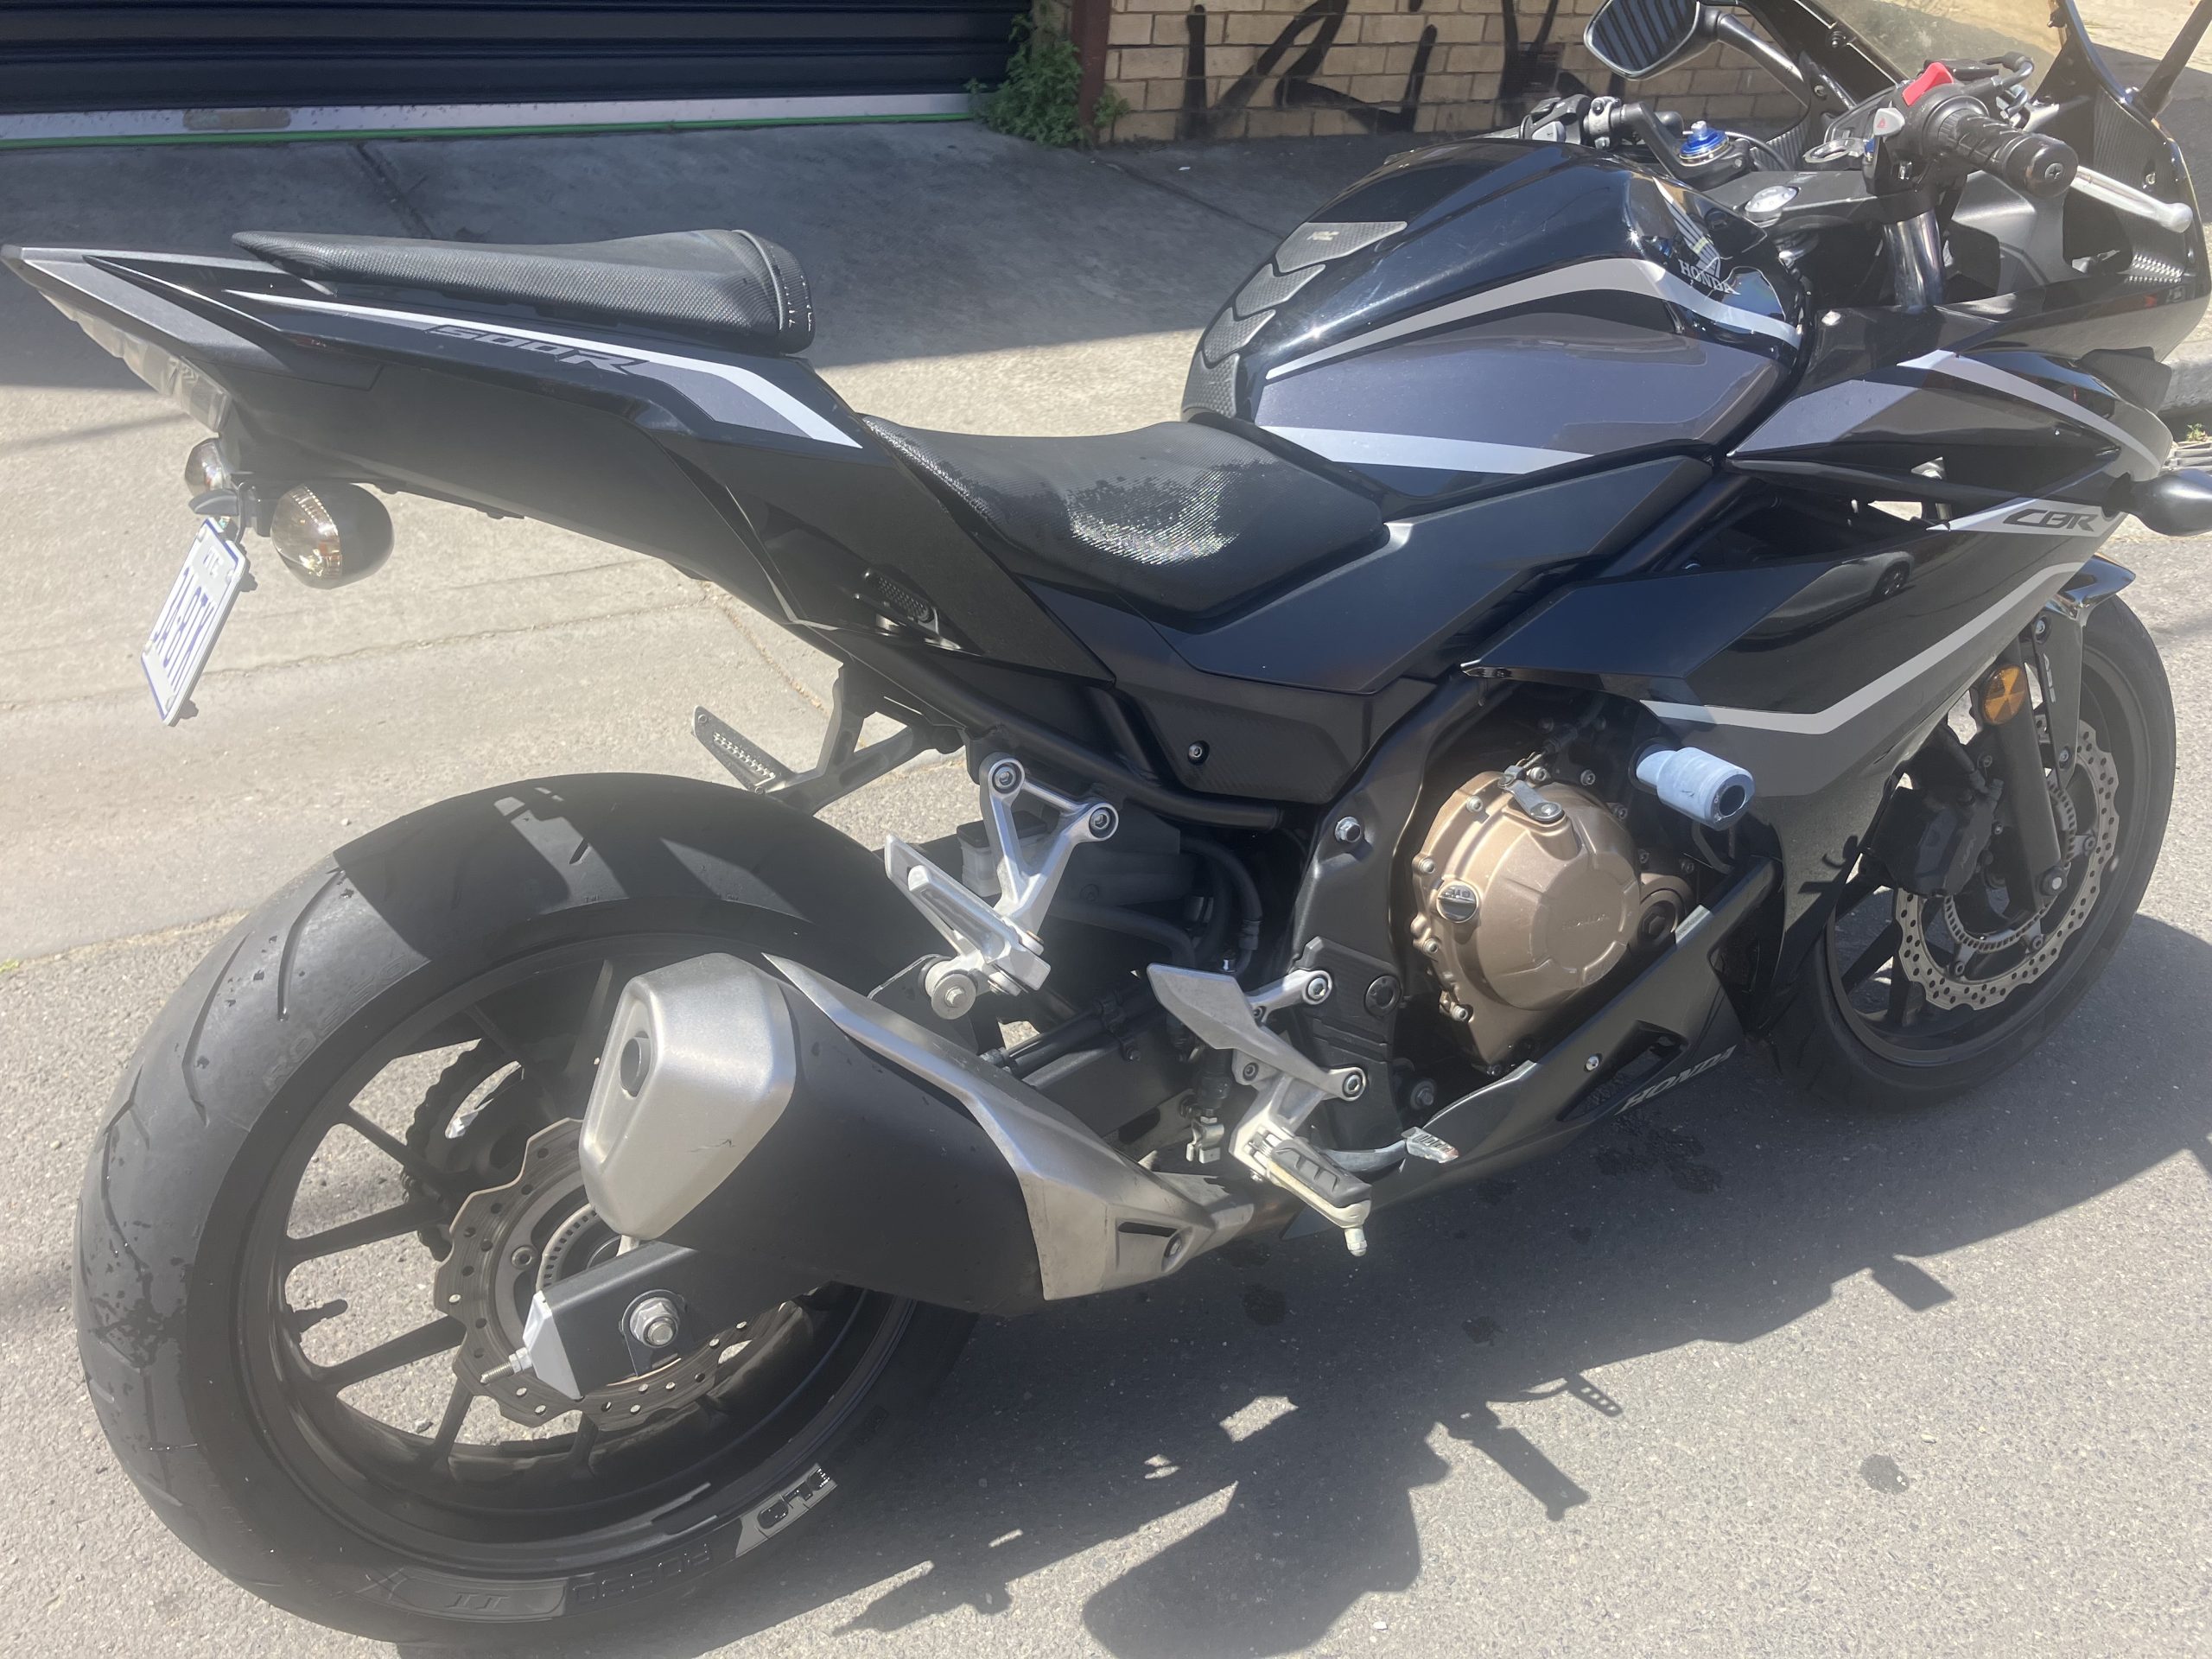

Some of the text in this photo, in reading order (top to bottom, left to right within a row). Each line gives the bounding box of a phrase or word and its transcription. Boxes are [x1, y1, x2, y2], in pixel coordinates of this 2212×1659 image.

[1678, 258, 1742, 296] HONDA
[429, 324, 636, 375] 500R
[2004, 508, 2099, 531] CBR
